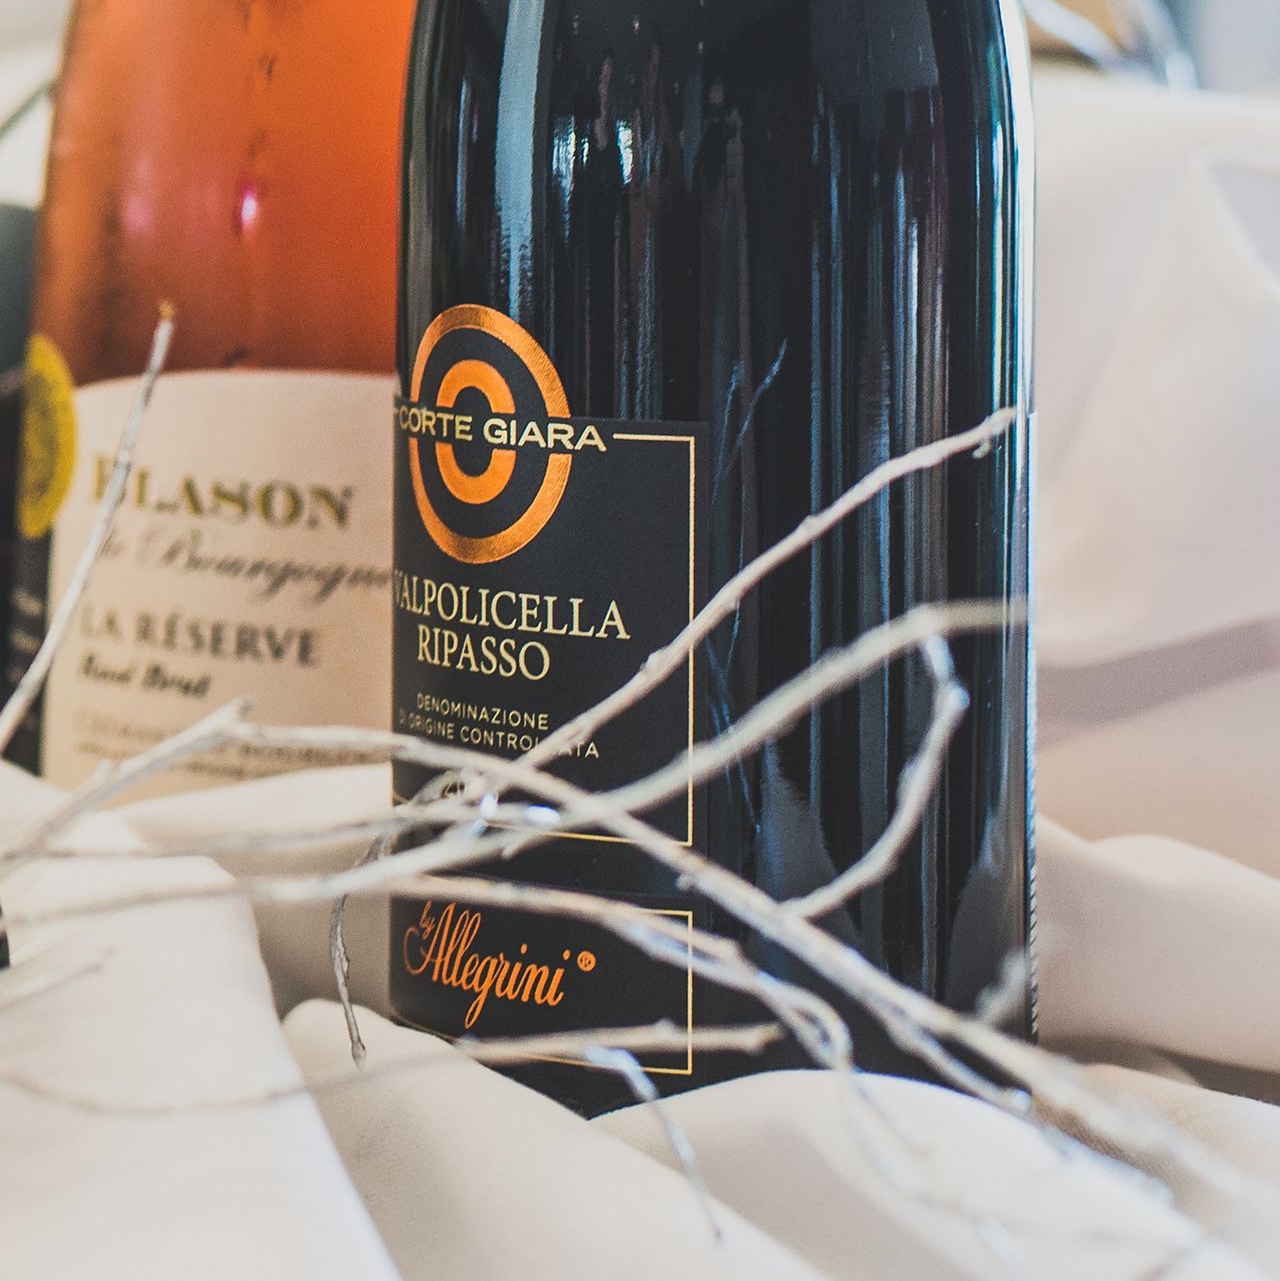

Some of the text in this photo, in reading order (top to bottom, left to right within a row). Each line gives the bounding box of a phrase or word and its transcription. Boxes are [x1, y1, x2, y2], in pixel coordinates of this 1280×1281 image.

[398, 405, 607, 452] CORTE GIARA
[83, 605, 127, 642] LA
[417, 624, 550, 681] RIPASSO
[417, 692, 549, 731] DENOMINAZIONE
[419, 900, 435, 940] by
